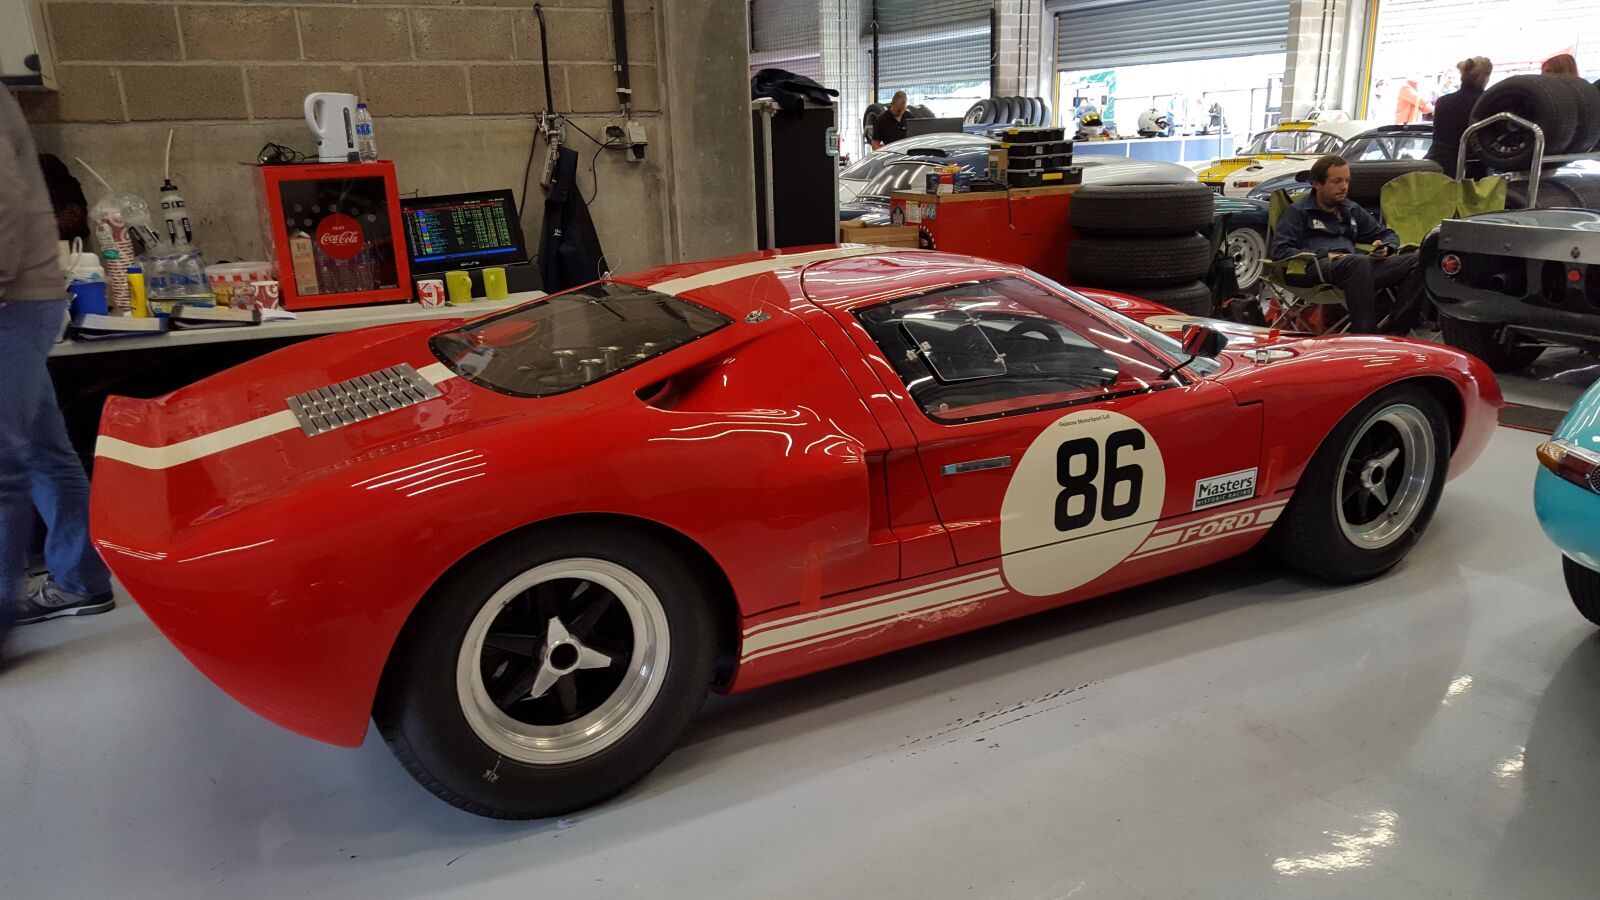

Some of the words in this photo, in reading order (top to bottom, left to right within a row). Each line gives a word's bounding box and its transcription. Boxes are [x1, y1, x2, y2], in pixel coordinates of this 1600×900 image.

[1054, 428, 1145, 532] 86
[1198, 477, 1252, 497] Masters
[1197, 495, 1226, 505] HISTORIC
[1228, 489, 1252, 499] RACING
[1181, 512, 1255, 542] FORD
